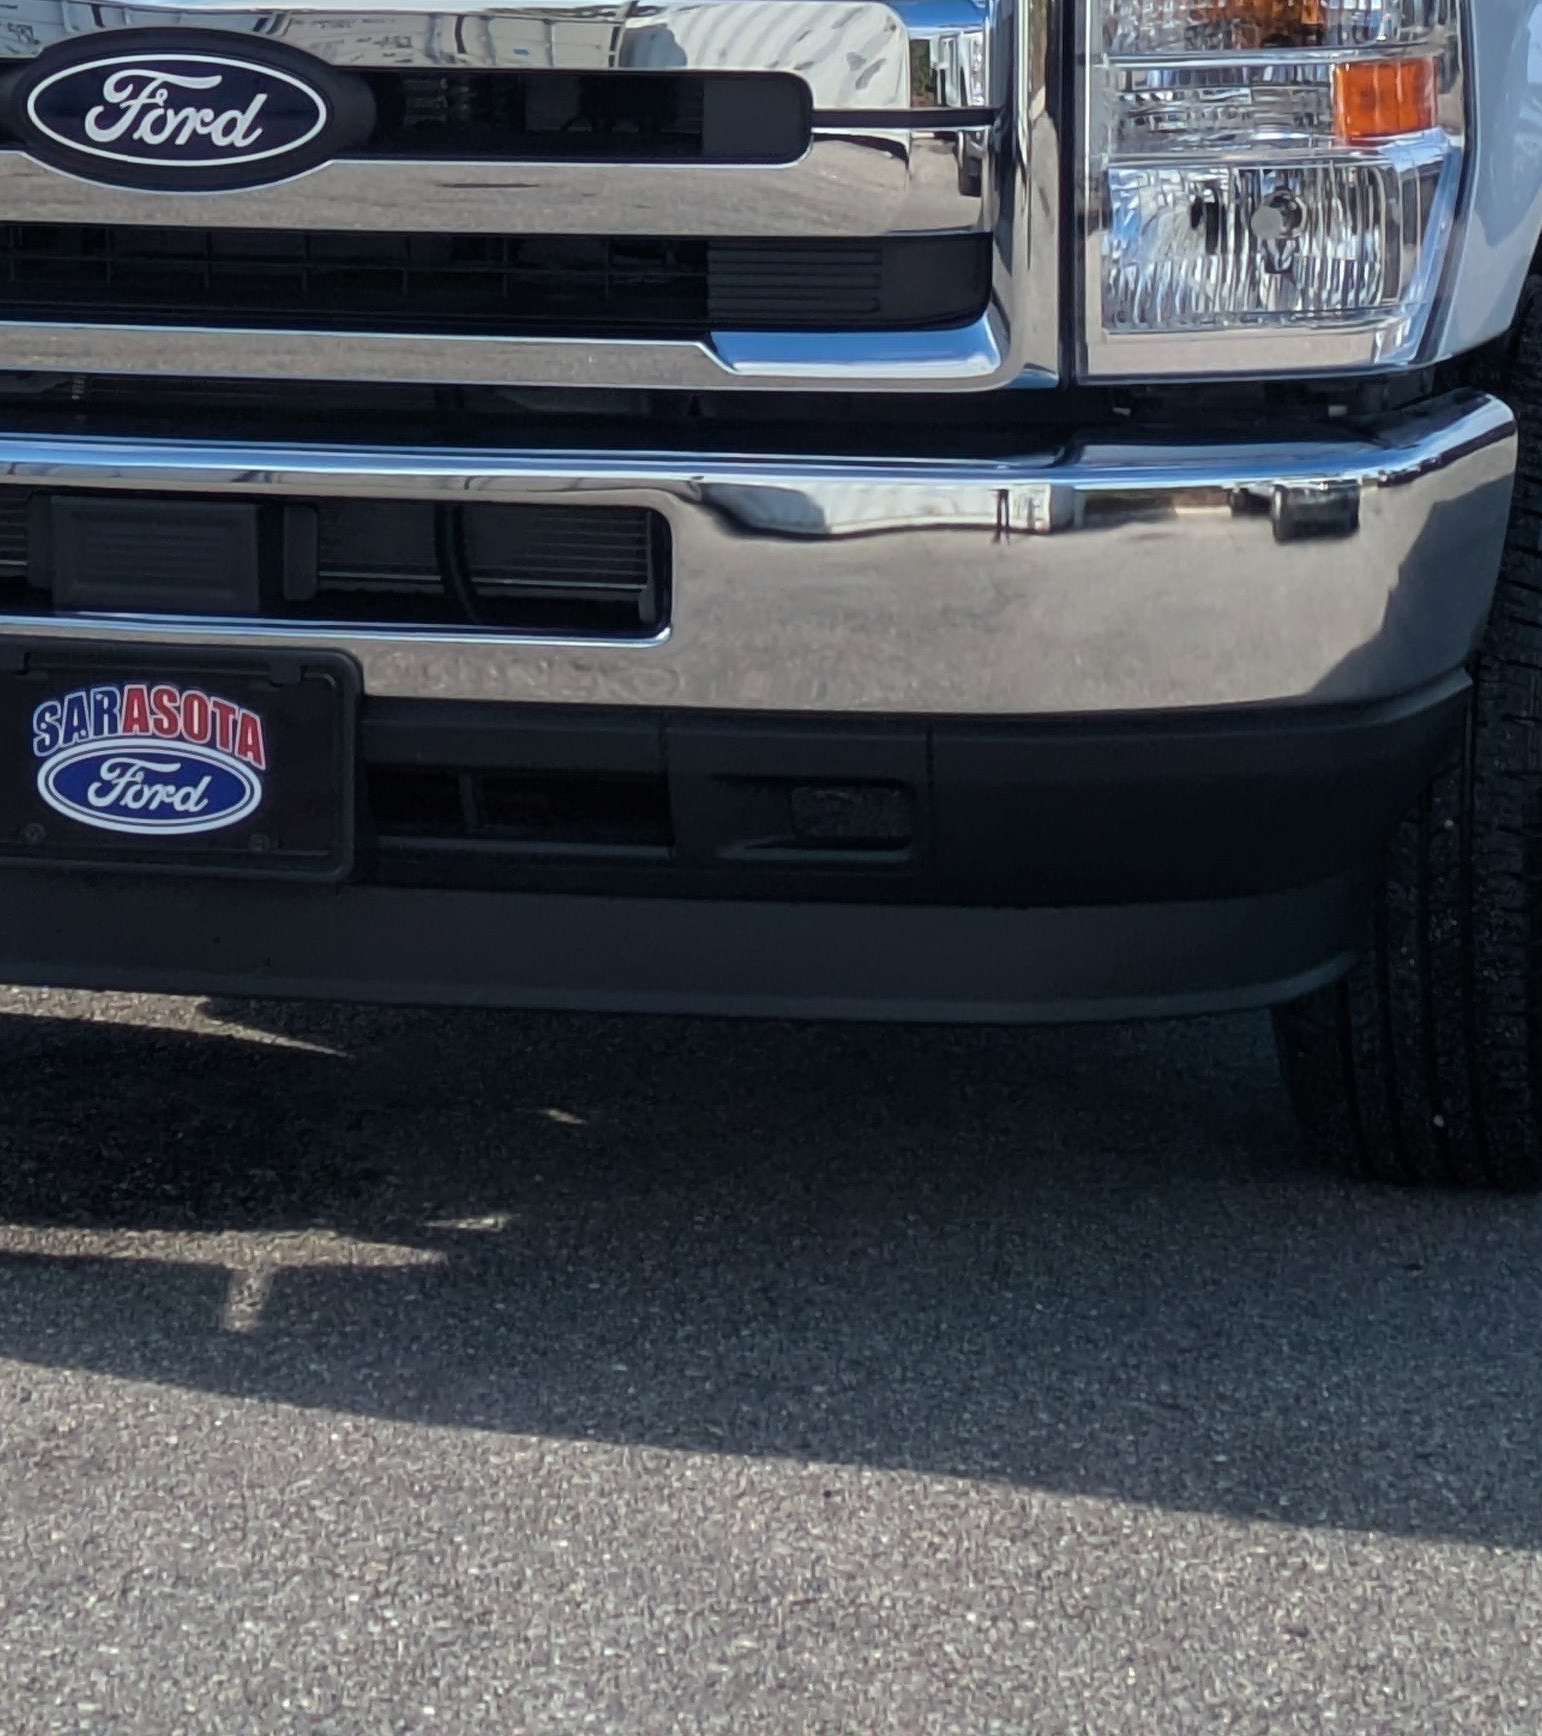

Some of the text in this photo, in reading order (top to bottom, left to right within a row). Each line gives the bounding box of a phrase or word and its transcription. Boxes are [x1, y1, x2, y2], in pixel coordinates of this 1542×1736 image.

[85, 68, 264, 148] Ford
[32, 683, 267, 771] SARASOTA
[87, 757, 211, 814] Ford
